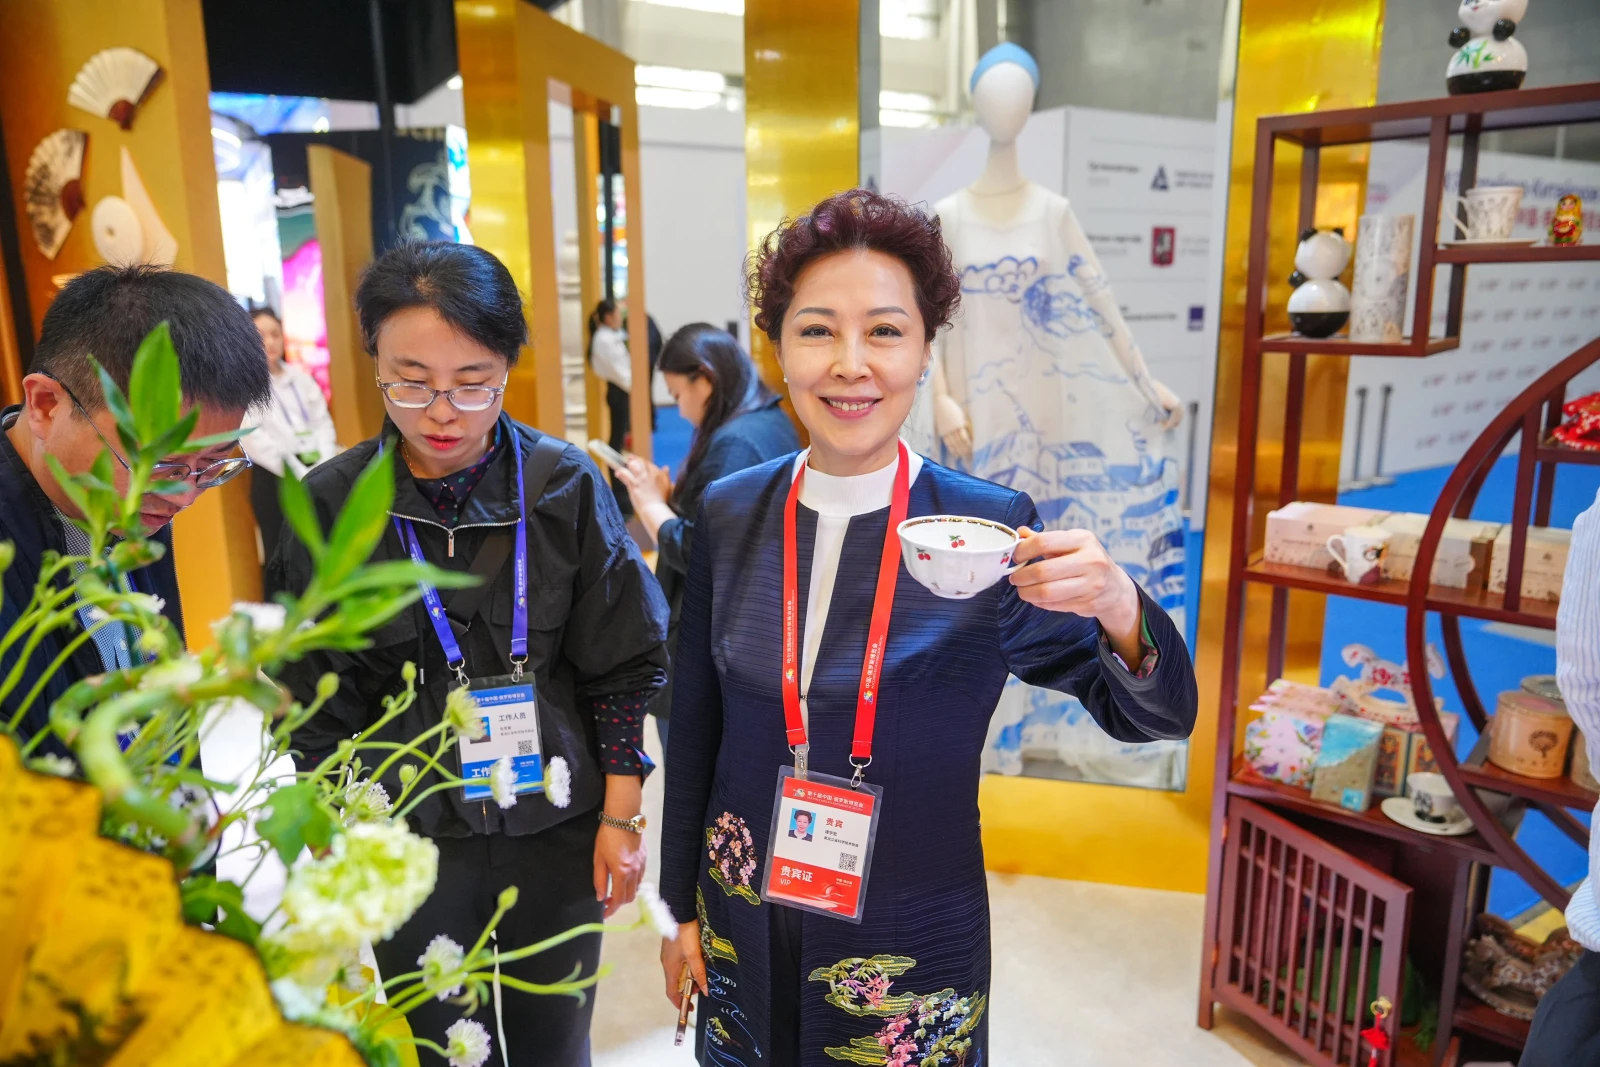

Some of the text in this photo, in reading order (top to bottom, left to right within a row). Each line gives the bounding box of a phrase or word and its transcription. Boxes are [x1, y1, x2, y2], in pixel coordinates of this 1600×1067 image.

[498, 712, 527, 722] 工作人员
[471, 767, 491, 778] 工作
[825, 817, 844, 829] 贵宾
[780, 865, 813, 883] 贵宾证
[780, 878, 791, 886] VIP
